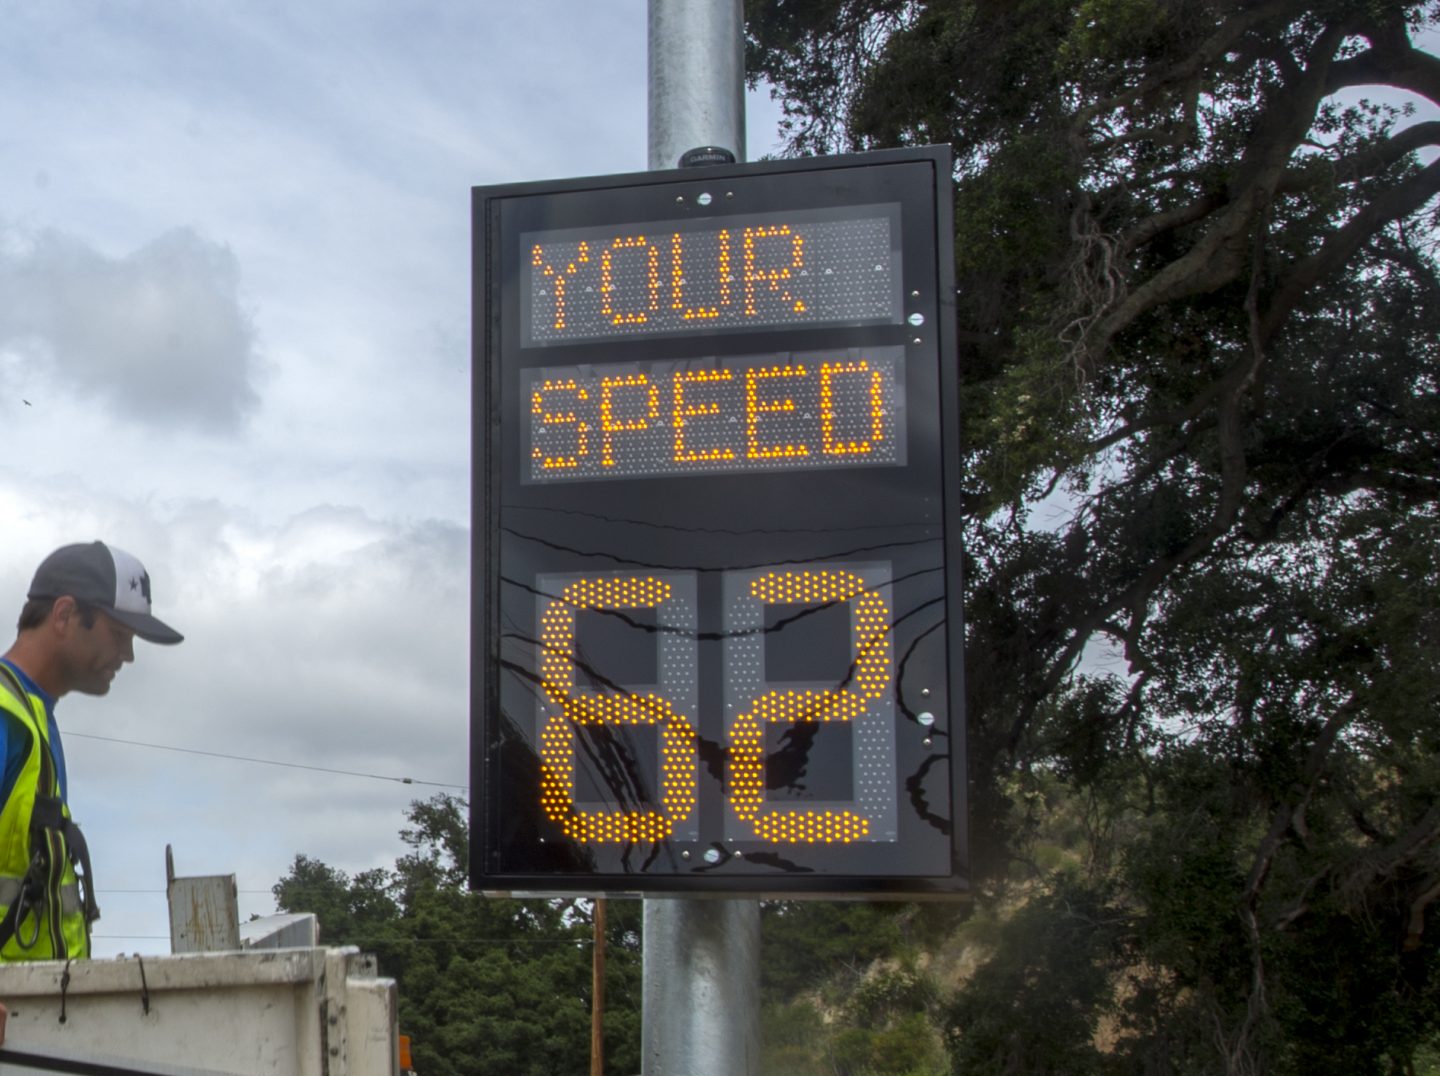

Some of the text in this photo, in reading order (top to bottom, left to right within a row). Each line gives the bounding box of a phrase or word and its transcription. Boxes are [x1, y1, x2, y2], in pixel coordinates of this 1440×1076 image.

[532, 224, 805, 329] YOUR
[531, 360, 884, 469] SPEED
[541, 570, 891, 844] 62
